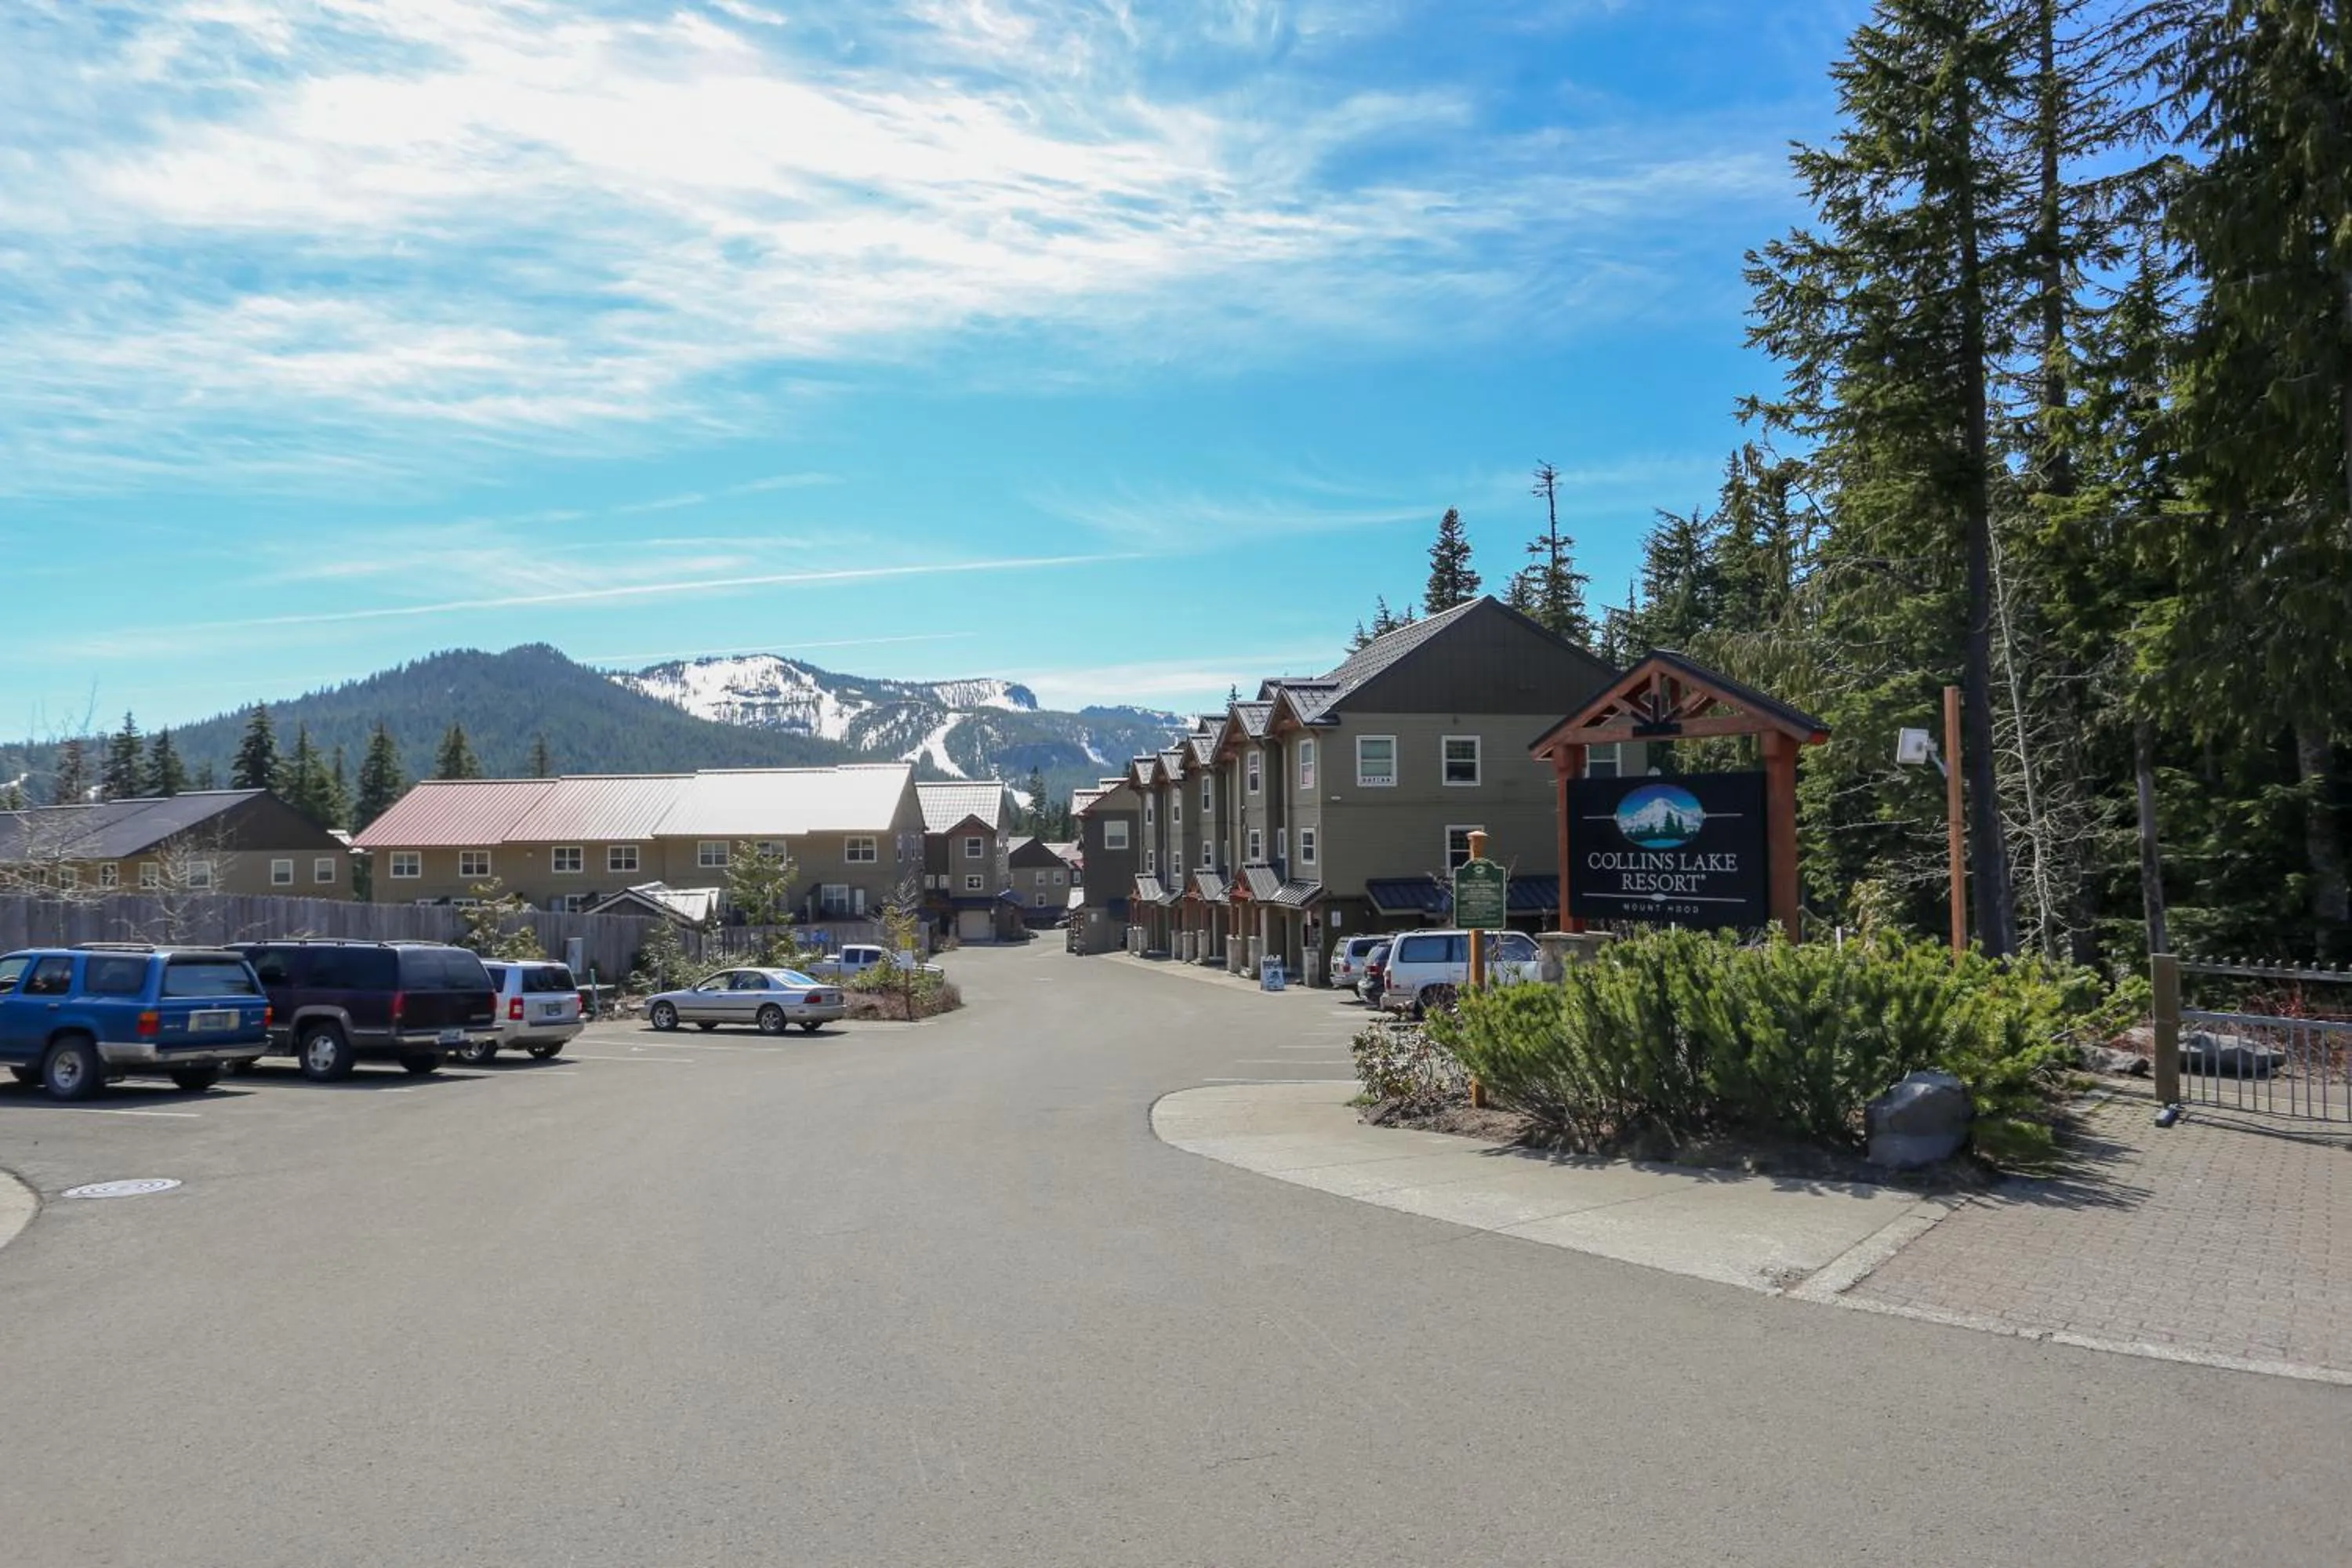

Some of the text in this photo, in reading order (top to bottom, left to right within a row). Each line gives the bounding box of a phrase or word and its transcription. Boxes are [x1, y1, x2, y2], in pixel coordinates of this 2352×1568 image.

[1588, 852, 1738, 872] COLLINS LAKE
[1623, 902, 1699, 914] MOUNT HOOD
